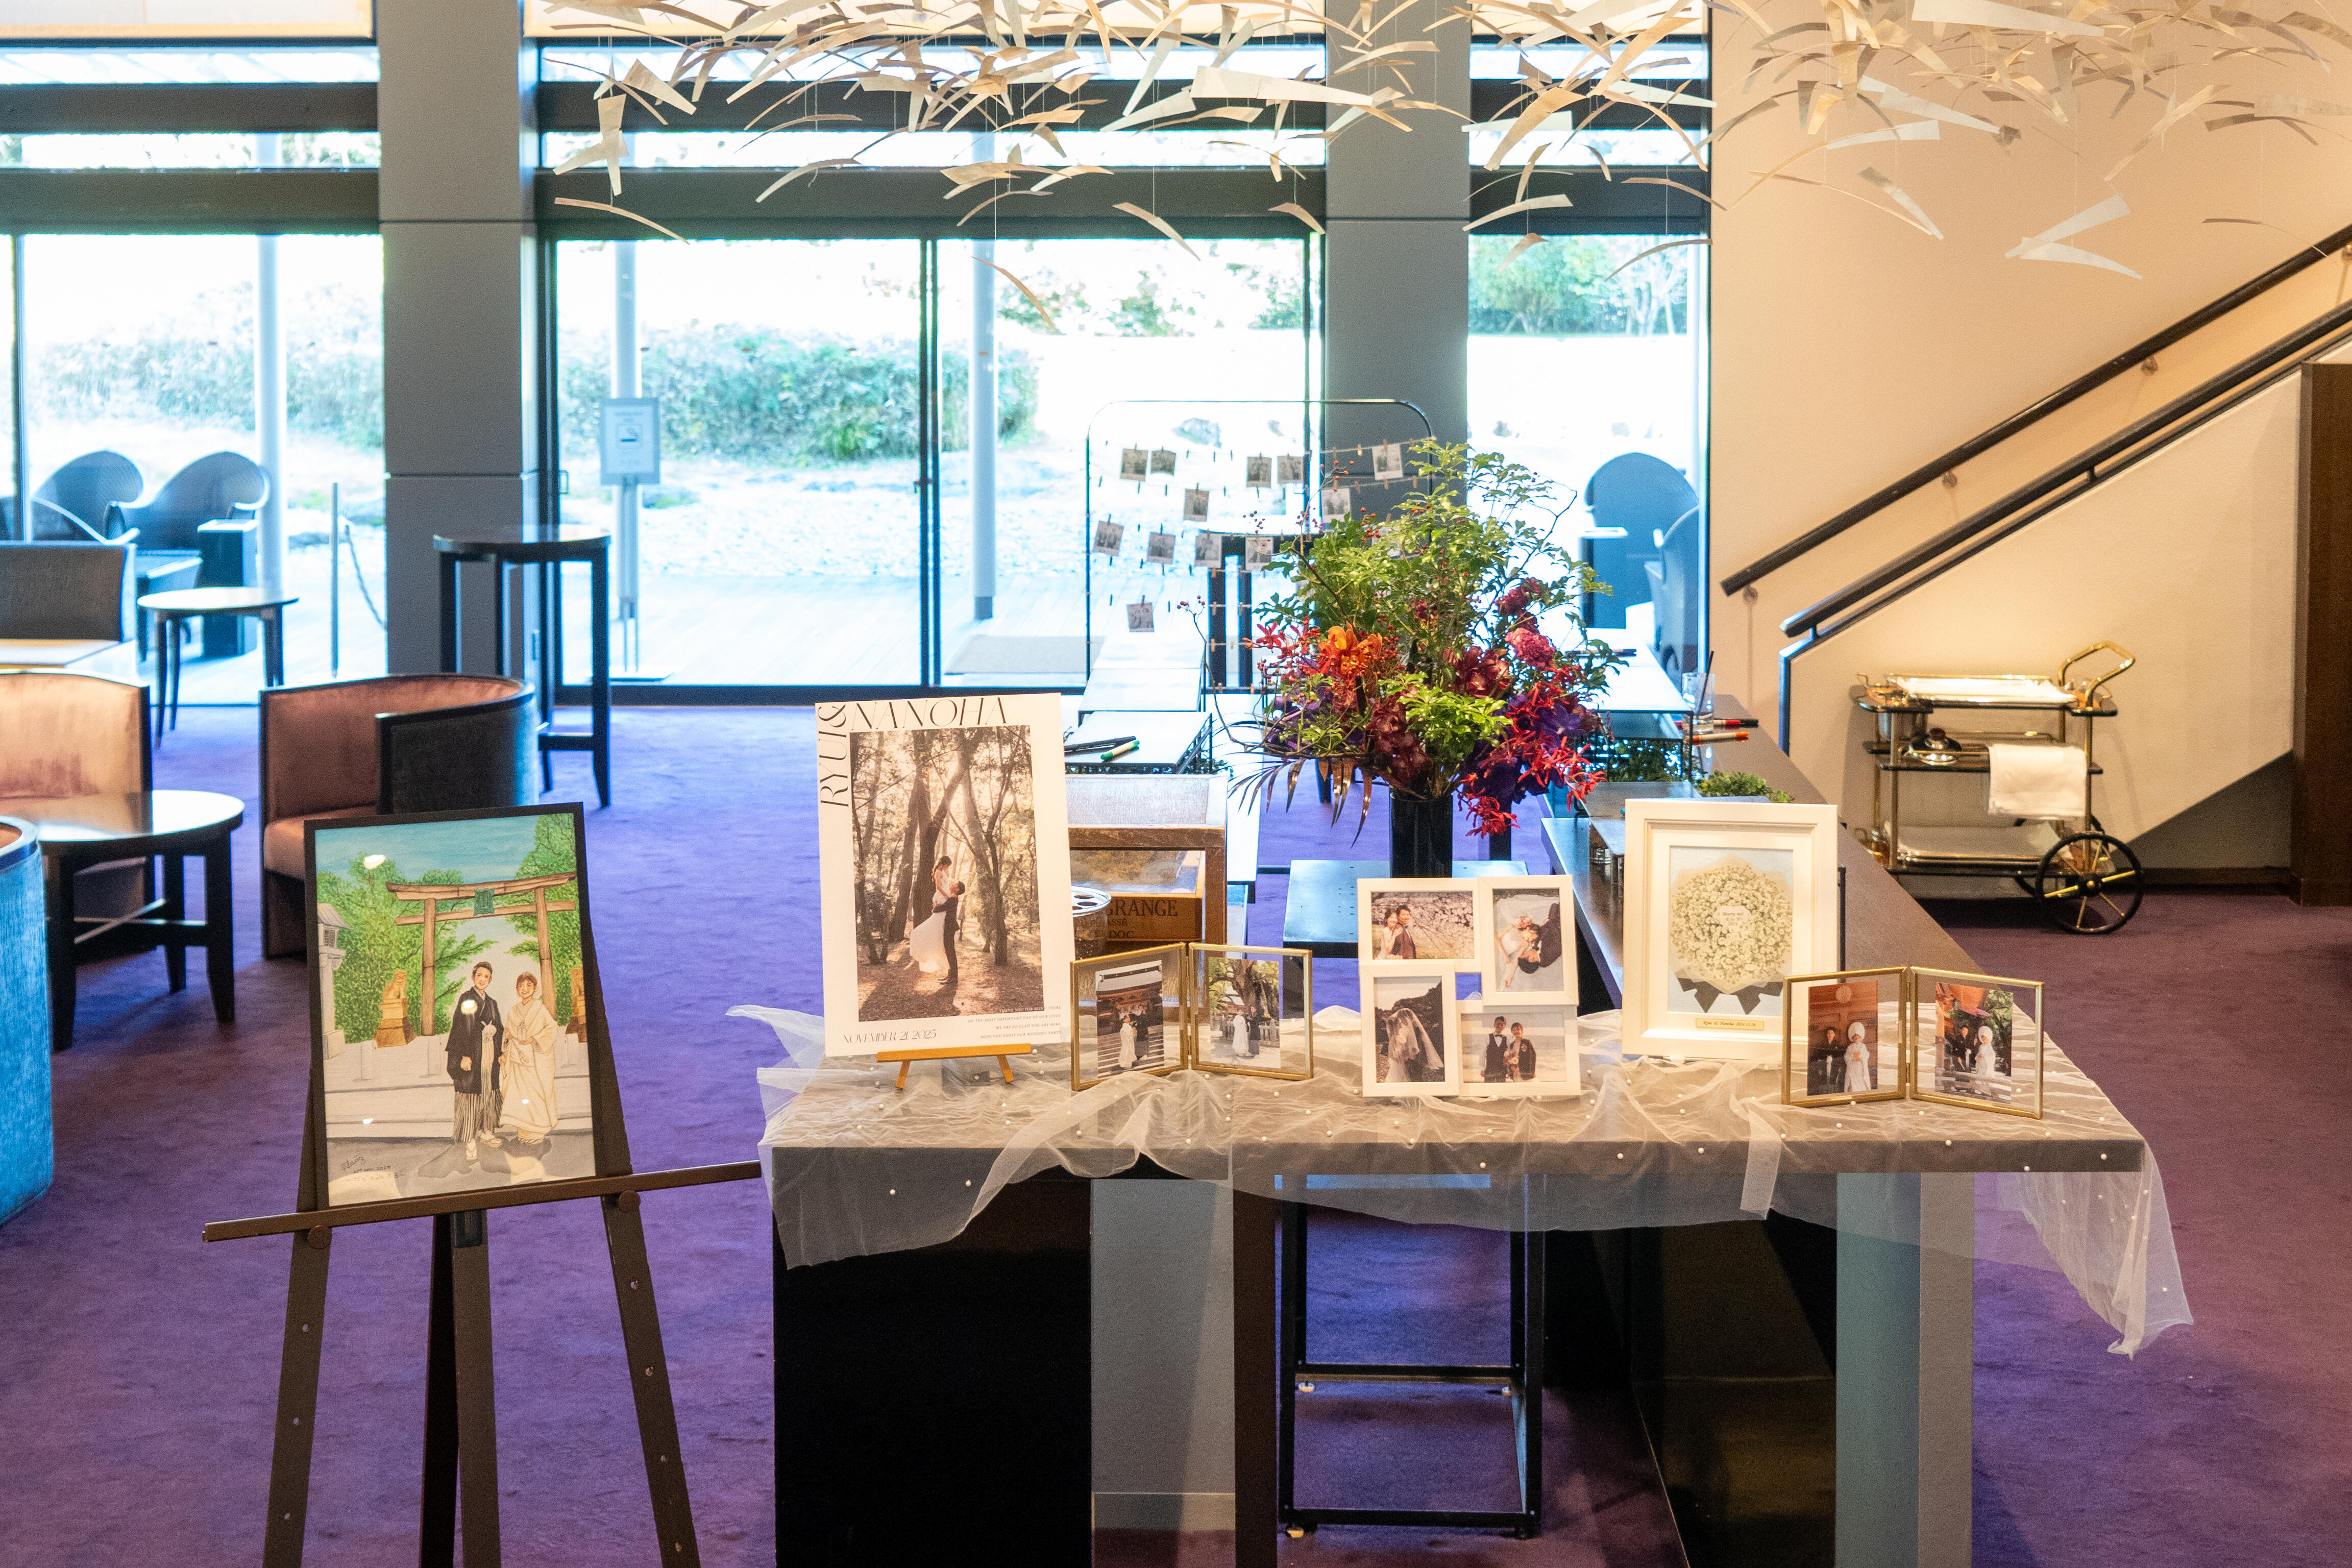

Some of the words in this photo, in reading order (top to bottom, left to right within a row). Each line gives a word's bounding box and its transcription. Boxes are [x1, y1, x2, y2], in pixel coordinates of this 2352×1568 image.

[851, 697, 1007, 730] NANOHA
[843, 1032, 897, 1043] NOVEMBER
[912, 1029, 937, 1040] 2025
